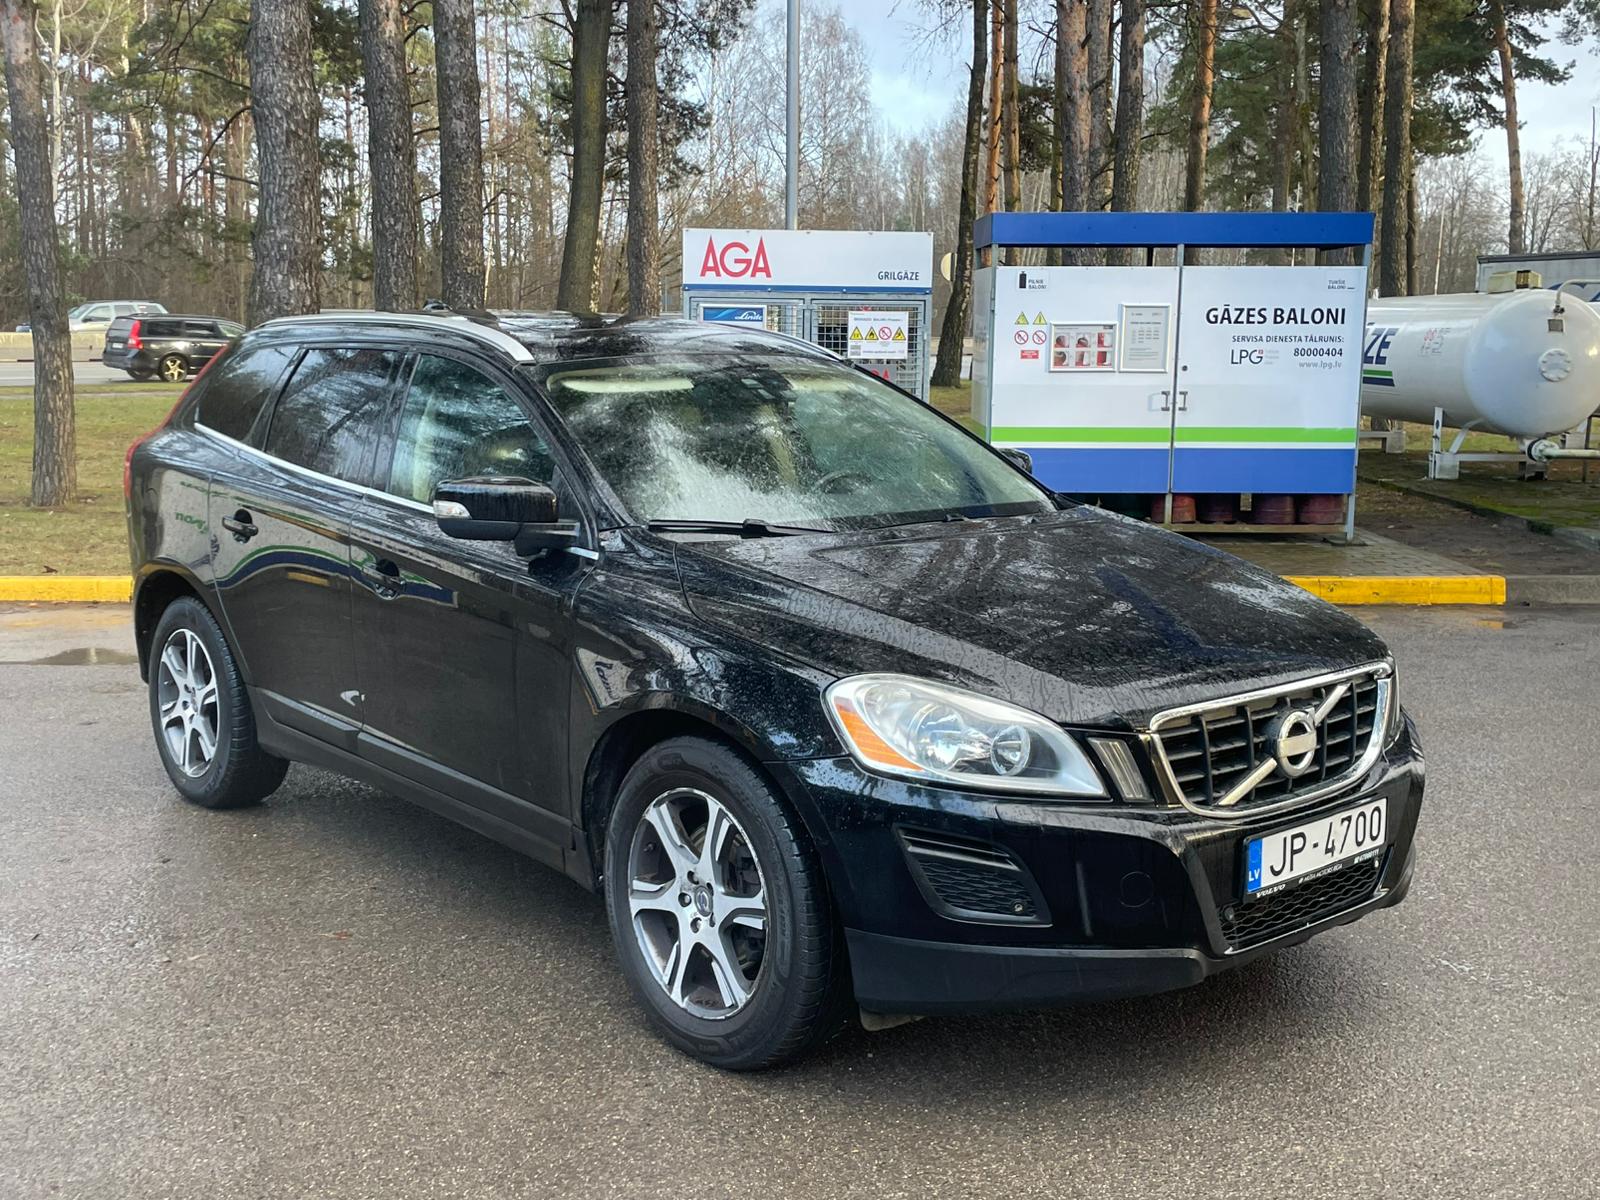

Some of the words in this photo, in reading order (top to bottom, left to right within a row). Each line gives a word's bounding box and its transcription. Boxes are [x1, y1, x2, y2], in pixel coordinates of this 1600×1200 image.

[700, 235, 772, 278] AGA
[877, 270, 920, 281] GRILGĀZE
[1206, 304, 1267, 325] GĀZES
[1273, 307, 1346, 325] BALONI
[1232, 335, 1264, 343] SERVISA
[1265, 335, 1303, 343] DIENESTA
[1304, 334, 1345, 343] TĀLRUNIS:
[1293, 347, 1343, 357] 80000404
[1363, 327, 1400, 365] ZE
[1230, 349, 1264, 365] LPG
[1298, 359, 1343, 370] www.lpg.lv
[1269, 806, 1381, 877] JP-4700
[1248, 868, 1260, 881] LV
